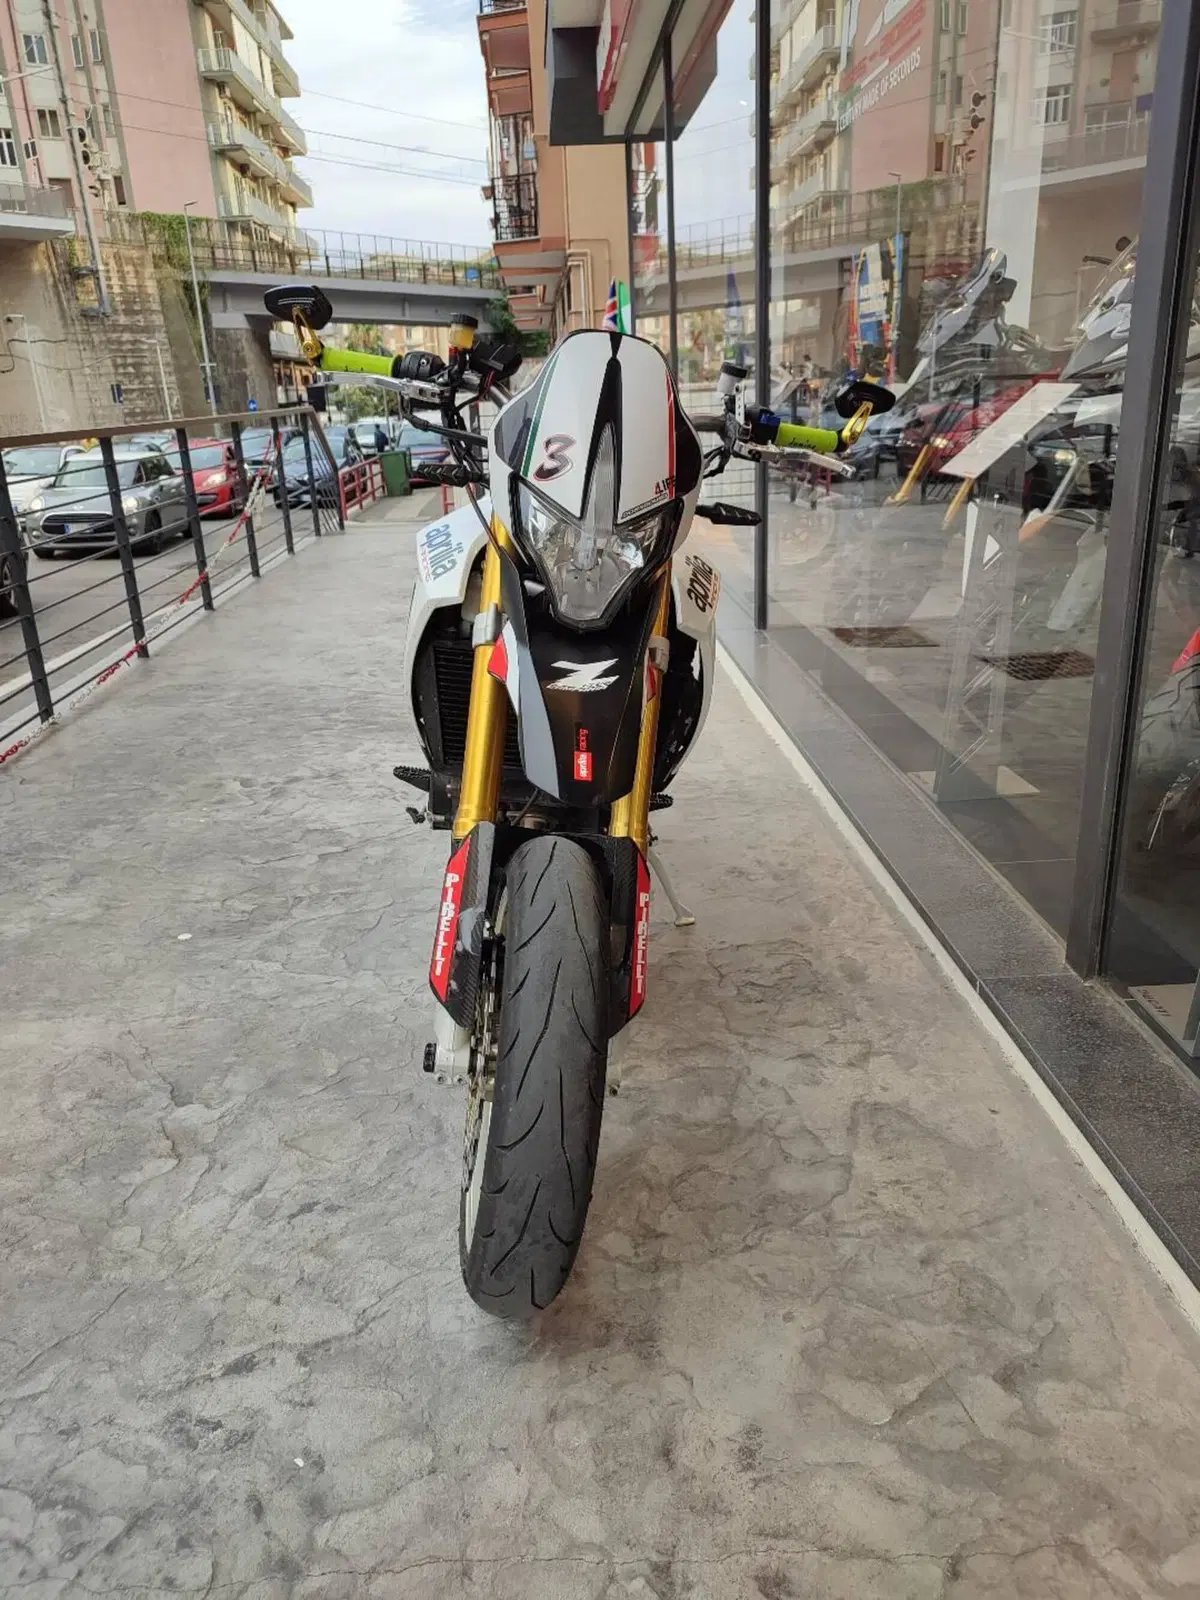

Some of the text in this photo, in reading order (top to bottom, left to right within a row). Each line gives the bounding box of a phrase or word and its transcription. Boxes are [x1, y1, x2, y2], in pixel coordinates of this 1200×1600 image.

[880, 75, 890, 97] OF
[889, 46, 921, 90] SECONDS
[420, 524, 464, 581] aprilia
[685, 555, 713, 613] aprilia
[577, 728, 589, 778] aprilia racing
[435, 872, 460, 976] PIRELLI
[636, 891, 650, 994] PIRELLI
